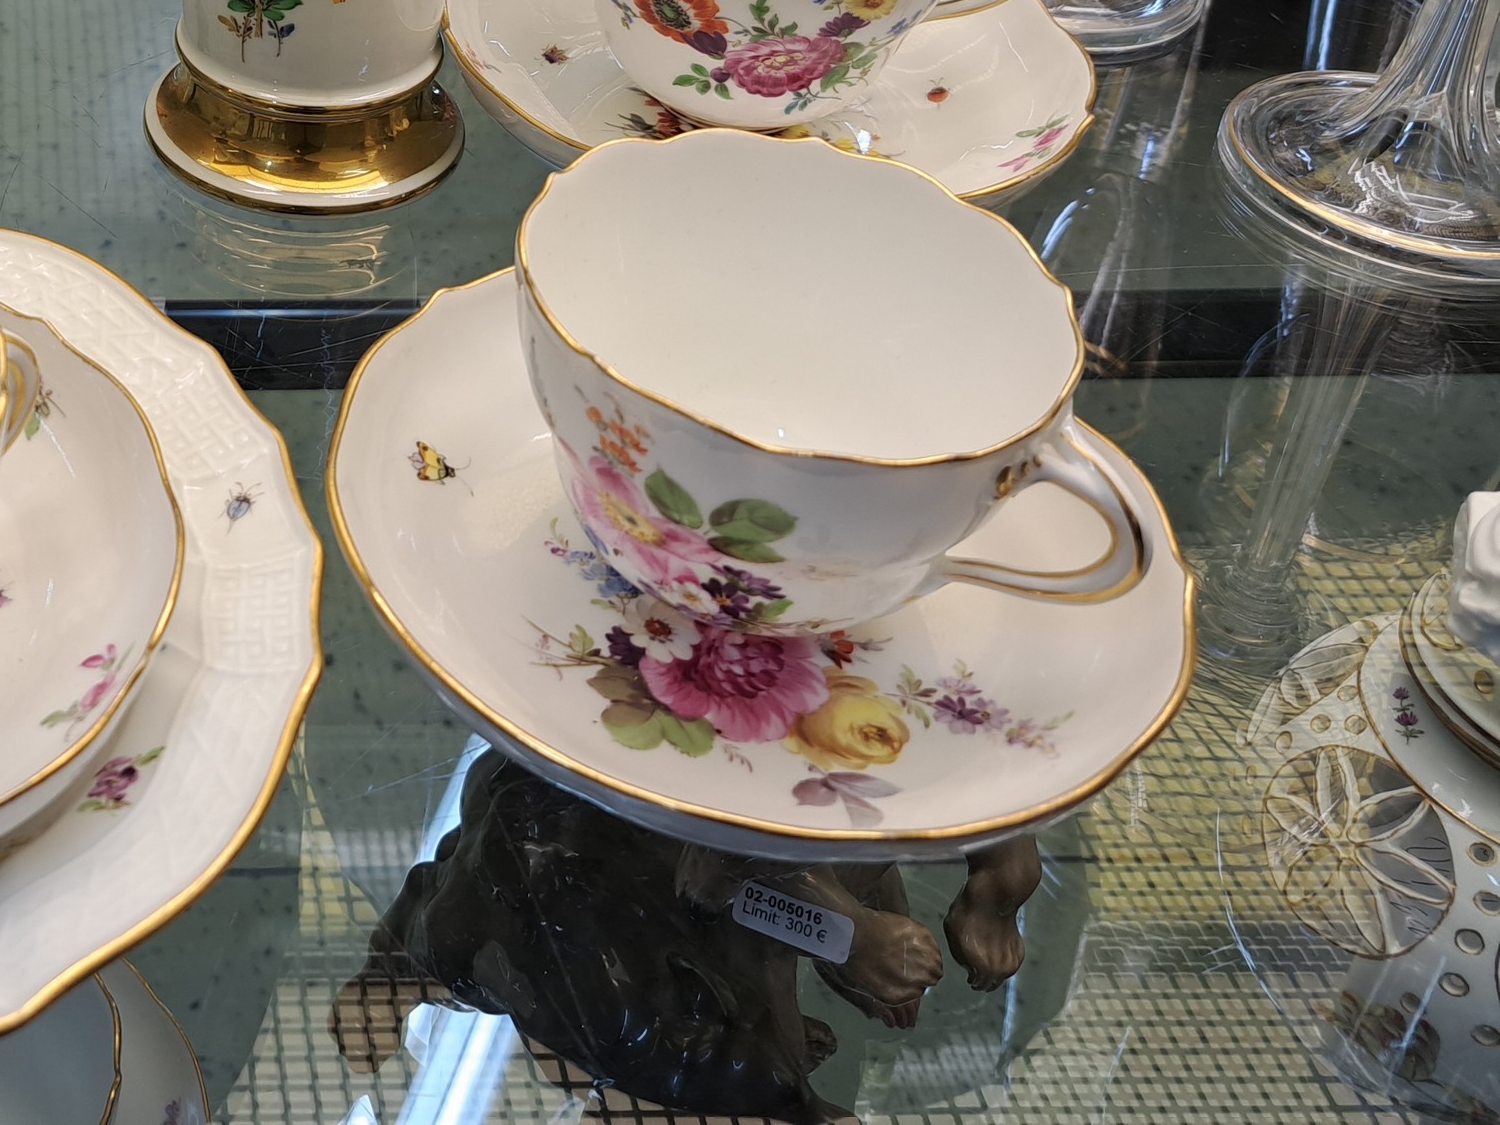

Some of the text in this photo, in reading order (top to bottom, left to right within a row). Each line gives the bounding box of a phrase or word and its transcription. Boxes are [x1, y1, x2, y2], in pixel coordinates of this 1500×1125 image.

[742, 900, 827, 943] Limit: 300 €
[745, 887, 823, 925] 02-005016
